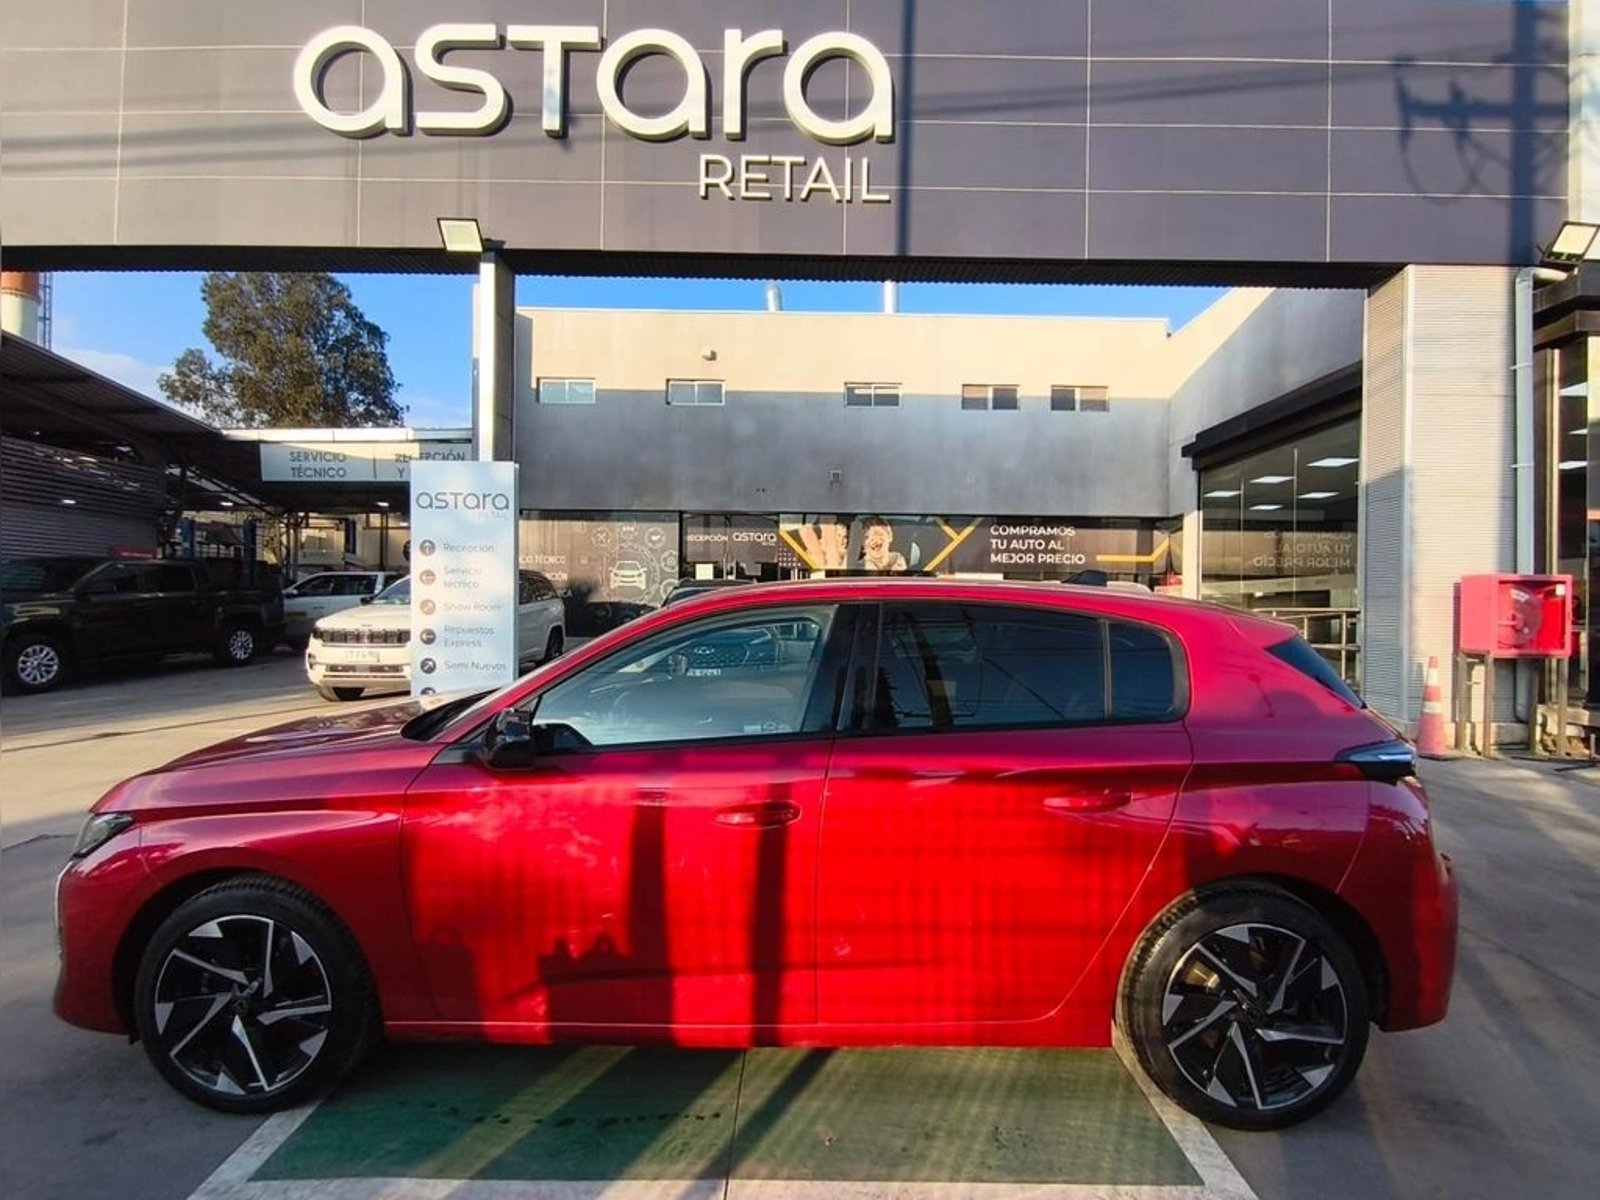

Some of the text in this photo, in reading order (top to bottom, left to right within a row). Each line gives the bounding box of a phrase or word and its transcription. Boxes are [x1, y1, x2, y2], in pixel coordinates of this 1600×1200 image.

[699, 154, 891, 203] RETAIL
[290, 451, 346, 463] SERVICIO
[290, 466, 347, 478] TÉCNICO
[398, 468, 406, 478] Y
[416, 492, 509, 510] astara
[990, 525, 1076, 536] COMPRAMOS
[732, 532, 777, 542] astara
[990, 539, 1065, 551] TU AUTO AL
[990, 553, 1086, 564] MEJOR PRECIO
[471, 661, 507, 671] Nuevos
